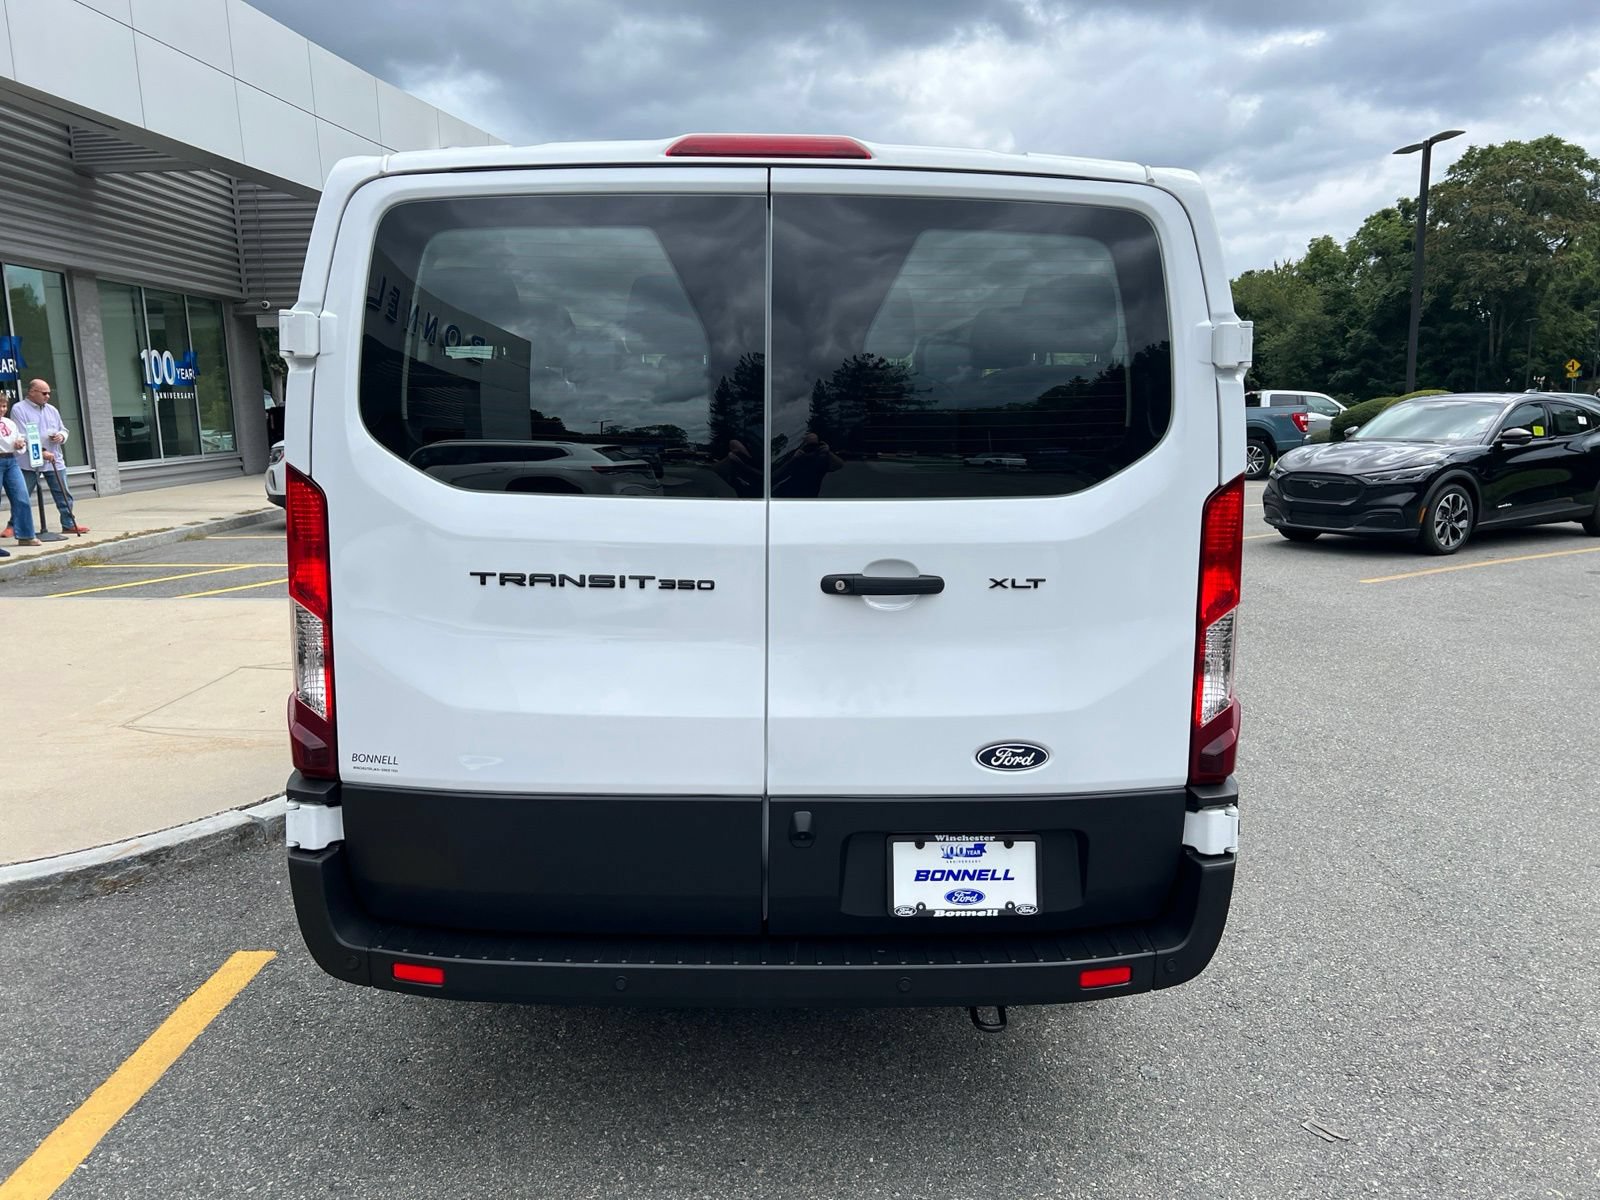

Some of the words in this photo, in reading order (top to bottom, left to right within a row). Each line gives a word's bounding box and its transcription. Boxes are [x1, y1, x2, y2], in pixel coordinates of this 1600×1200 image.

[140, 349, 176, 385] 100
[988, 578, 1046, 589] XLT
[351, 752, 399, 766] BONNELL
[990, 747, 1036, 766] Ford
[934, 834, 996, 842] Winchester
[914, 869, 1015, 882] BONNELL
[951, 890, 978, 904] Ford
[933, 909, 999, 918] Bonnell
